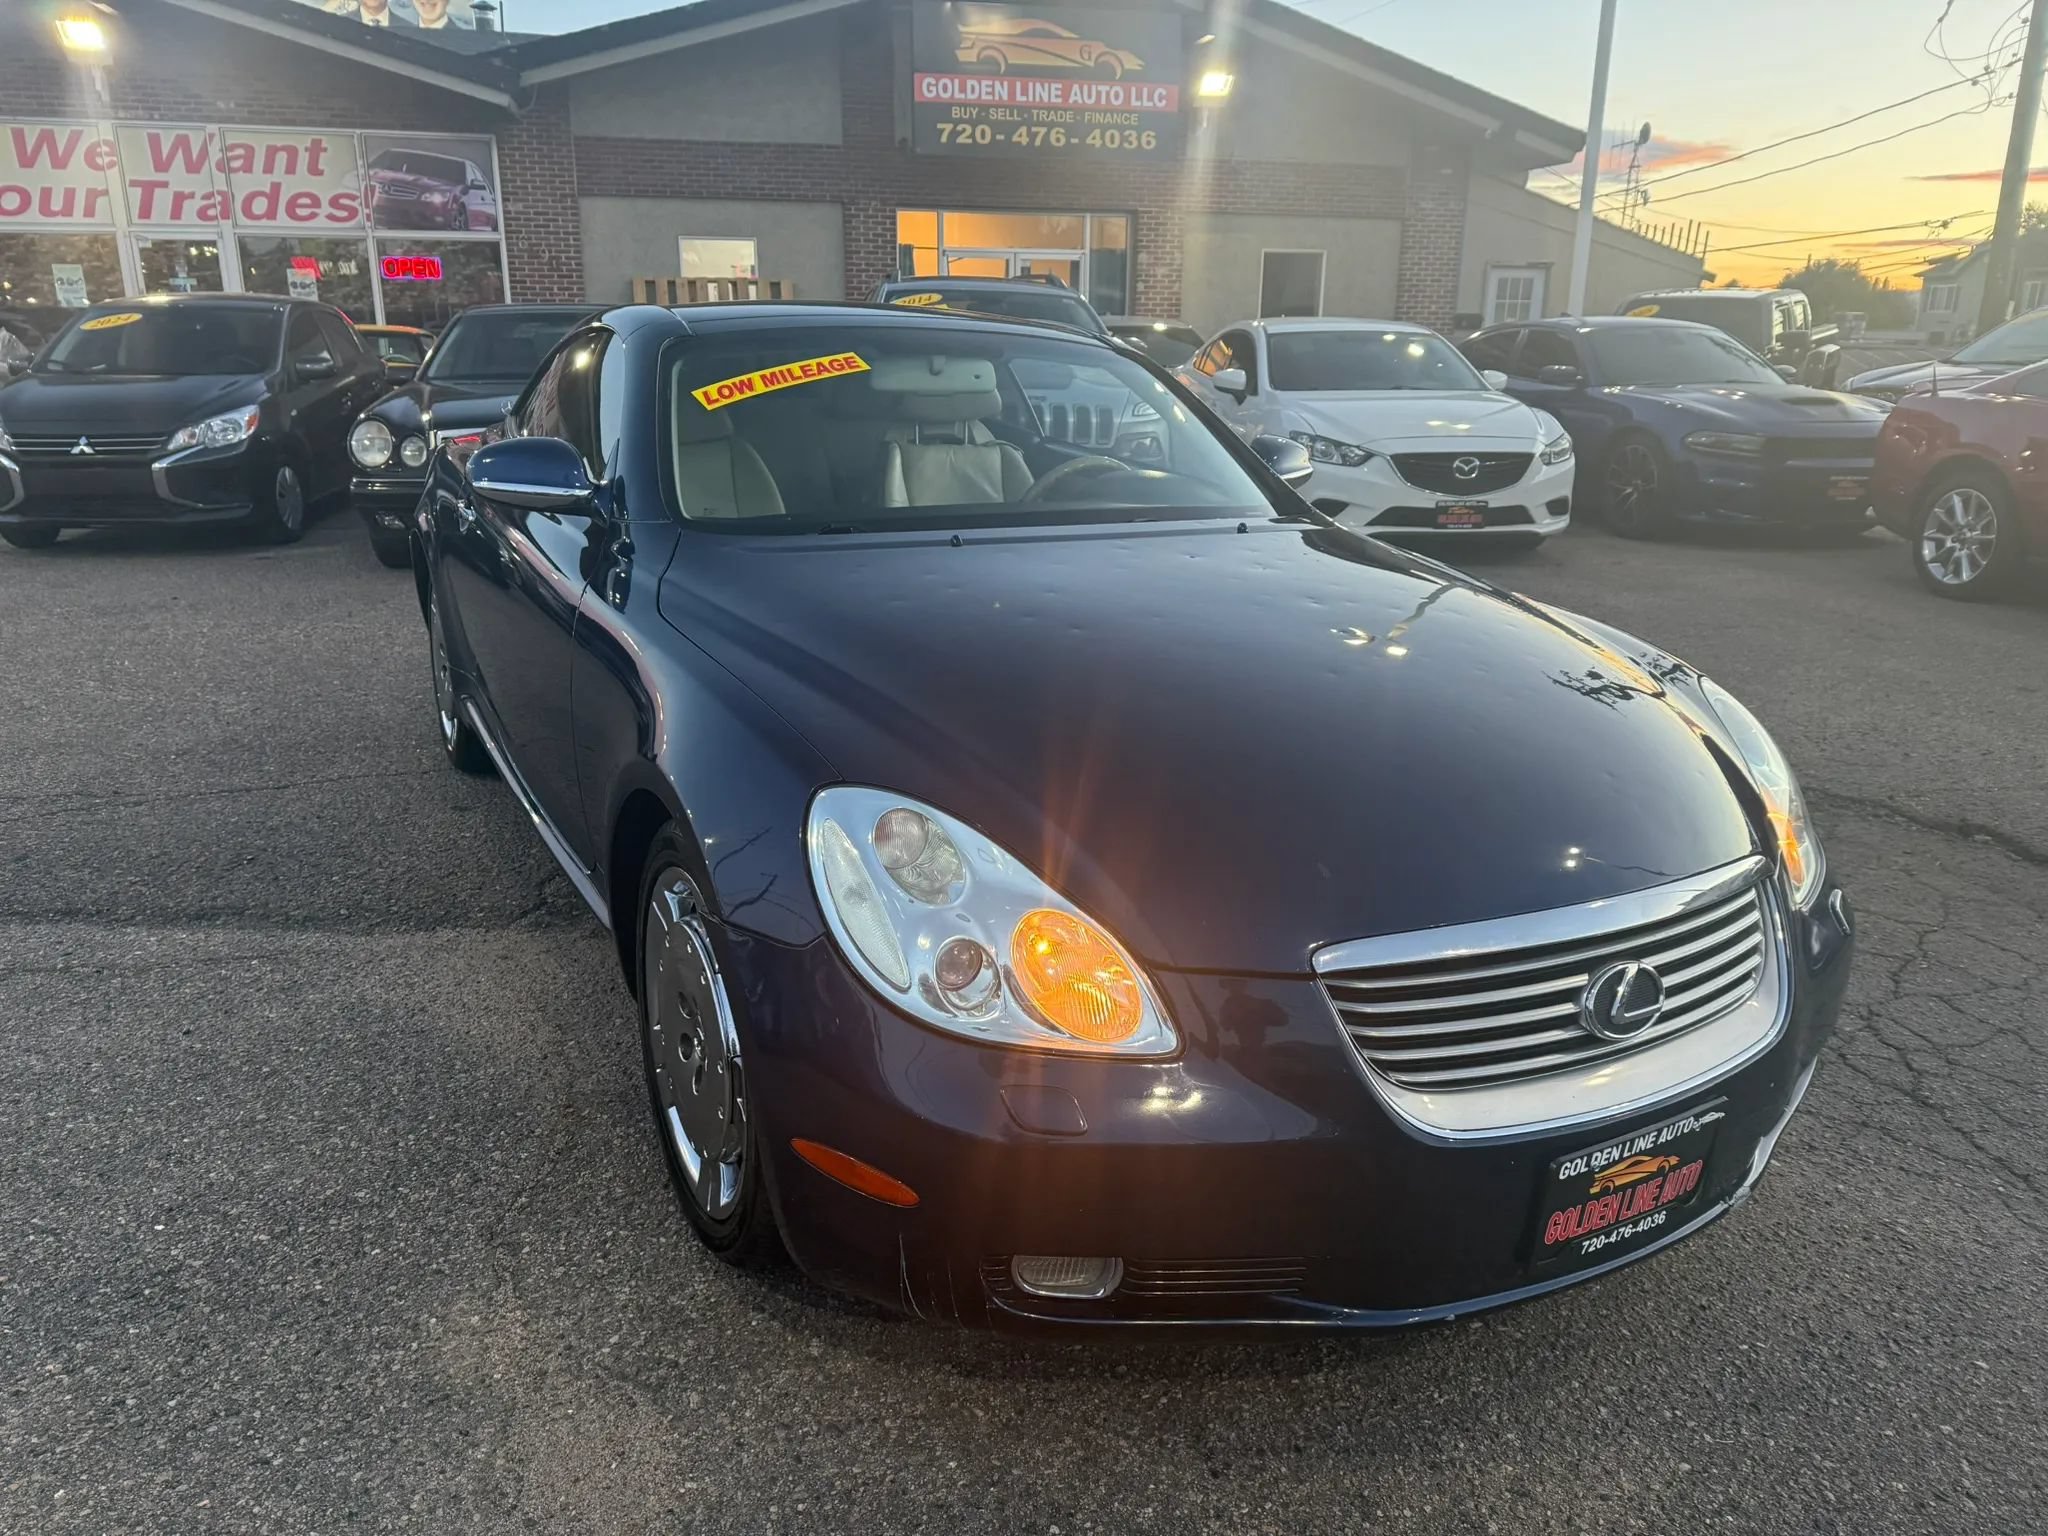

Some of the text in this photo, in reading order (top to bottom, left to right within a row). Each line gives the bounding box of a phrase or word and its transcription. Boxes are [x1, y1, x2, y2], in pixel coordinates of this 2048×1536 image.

[922, 77, 1167, 107] GOLDEN LINE AUTO LLC
[952, 106, 978, 119] BUY
[989, 107, 1021, 120] SELL
[1031, 109, 1074, 123] TRADE
[1084, 111, 1139, 125] FINANCE
[10, 127, 328, 176] We Want
[382, 257, 442, 279] OPEN
[702, 356, 861, 406] LOW MILEAGE
[1559, 1117, 1695, 1180] GOLDEN LINE AUTO
[1544, 1160, 1703, 1245] GOLDEN LINE AUTO
[1581, 1210, 1667, 1255] 720-476-4036
